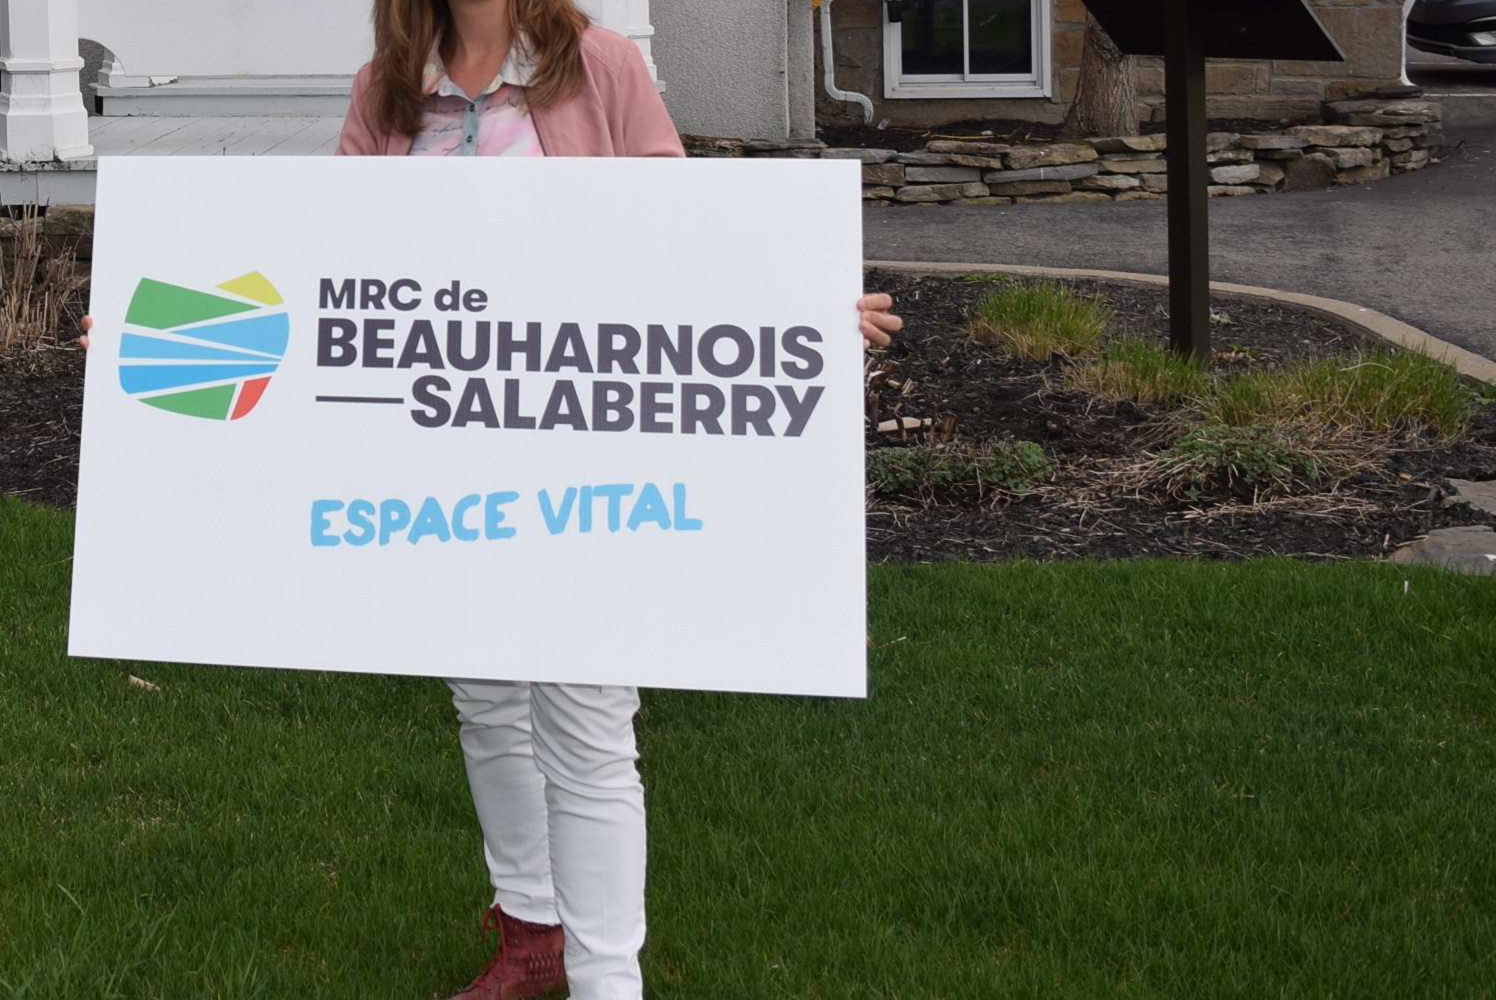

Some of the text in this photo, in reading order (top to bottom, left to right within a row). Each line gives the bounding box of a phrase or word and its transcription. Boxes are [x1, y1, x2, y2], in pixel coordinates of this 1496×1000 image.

[318, 278, 488, 312] MRC de
[316, 318, 824, 380] BEAUHARNOIS
[410, 375, 825, 437] SALABERRY
[310, 482, 703, 547] ESPACE VITAL
